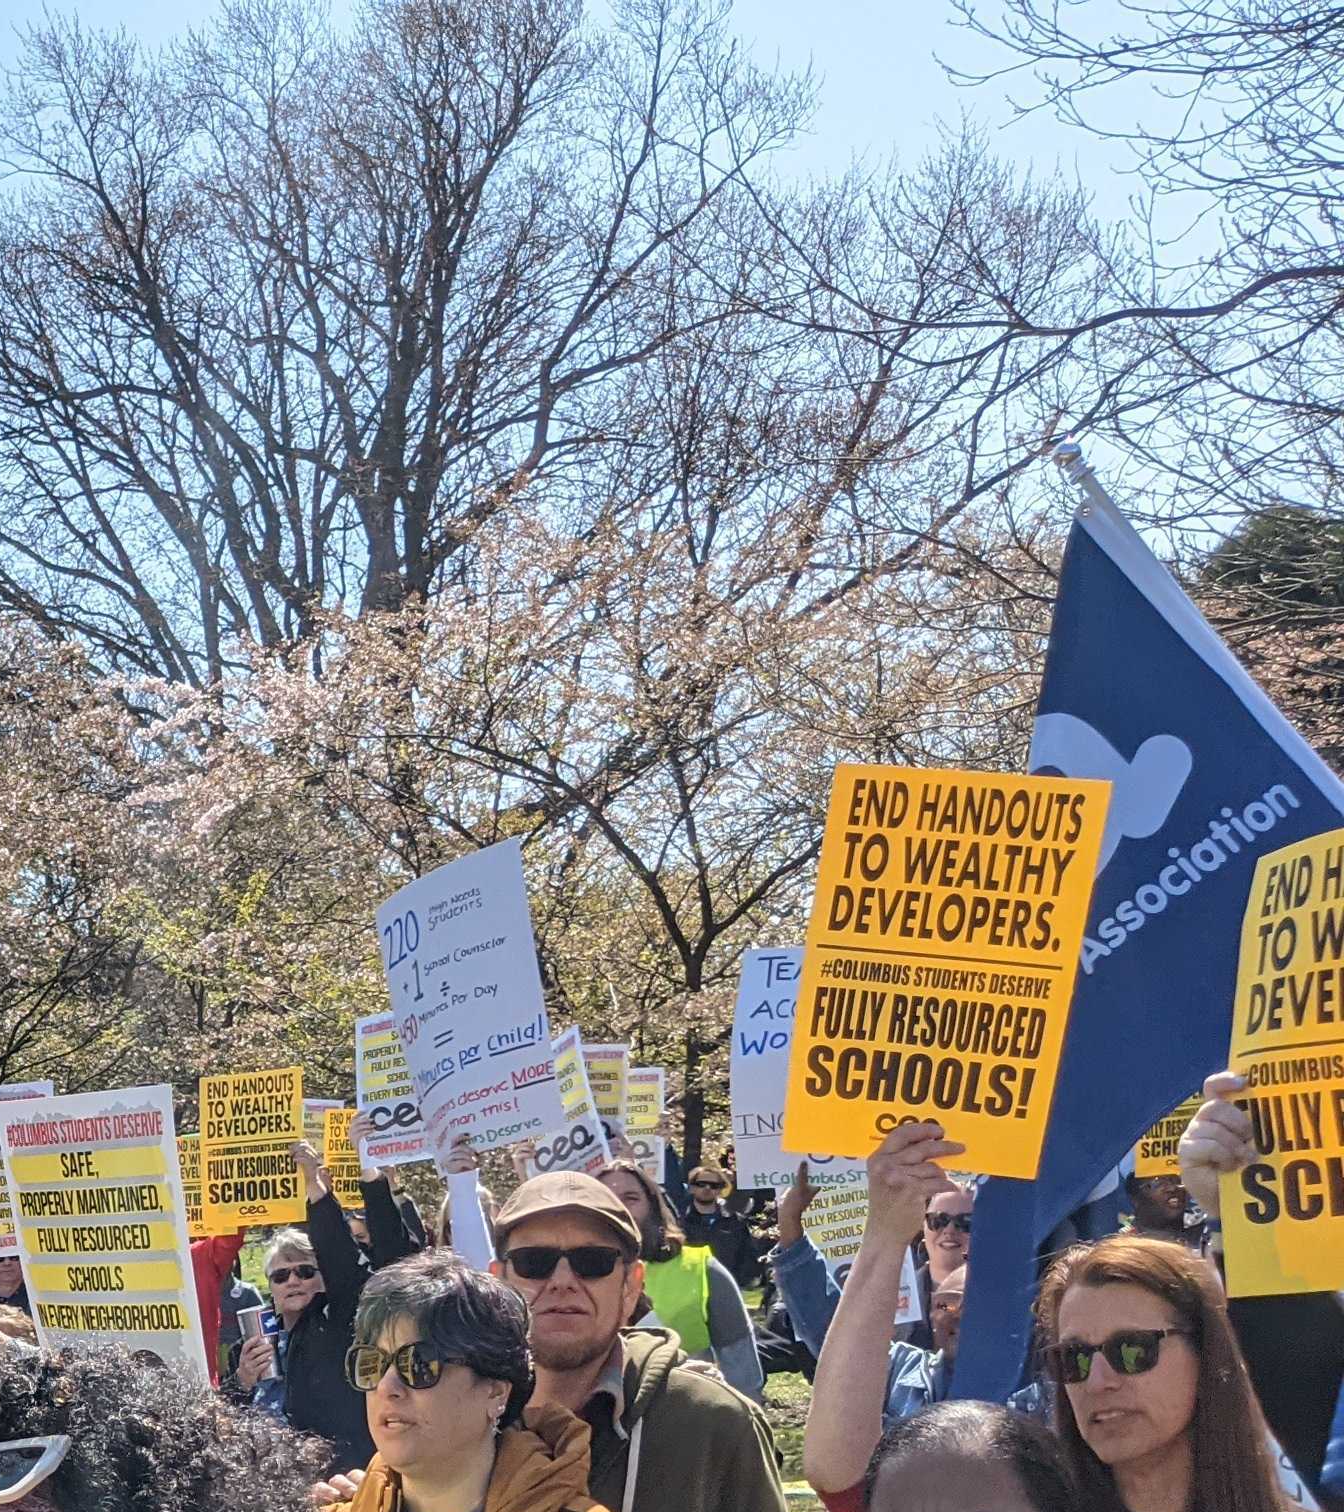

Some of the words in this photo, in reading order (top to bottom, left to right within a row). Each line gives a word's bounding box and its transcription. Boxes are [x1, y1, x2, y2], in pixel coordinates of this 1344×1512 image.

[847, 779, 910, 828] END
[915, 784, 1086, 844] HANDOUTS
[843, 832, 888, 881] TO
[903, 840, 1075, 897] WEALTHY
[1079, 783, 1302, 975] Association
[827, 884, 1061, 953] DEVELOPERS.
[819, 959, 910, 985] #COLUMBUS
[913, 967, 985, 994] STUDENTS
[989, 974, 1052, 999] DESERVE
[809, 985, 887, 1040] FULLY
[887, 992, 1047, 1061] RESOURCED
[207, 1081, 229, 1099] END
[233, 1073, 294, 1096] HANDOUTS
[512, 1060, 555, 1087] MORE
[804, 1044, 1036, 1119] SCHOOLS!
[208, 1102, 225, 1118] TO
[231, 1093, 294, 1116] WEALTHY
[7, 1121, 59, 1148] #COLUMBUS
[59, 1116, 111, 1142] STUDENTS
[112, 1111, 163, 1138] DESERVE
[207, 1114, 295, 1138] DEVELOPERS.
[60, 1152, 99, 1178] SAFE,
[208, 1158, 235, 1181] FULLY
[20, 1189, 76, 1218] PROPERLY
[76, 1183, 164, 1214] MAINTAINED,
[209, 1178, 297, 1204] SCHOOLS!
[37, 1227, 72, 1253] FULLY
[73, 1224, 151, 1250] RESOURCED
[67, 1267, 124, 1291] SCHOOLS
[50, 1306, 80, 1329] EVERY
[81, 1304, 184, 1331] NEIGHBORHOOD.
